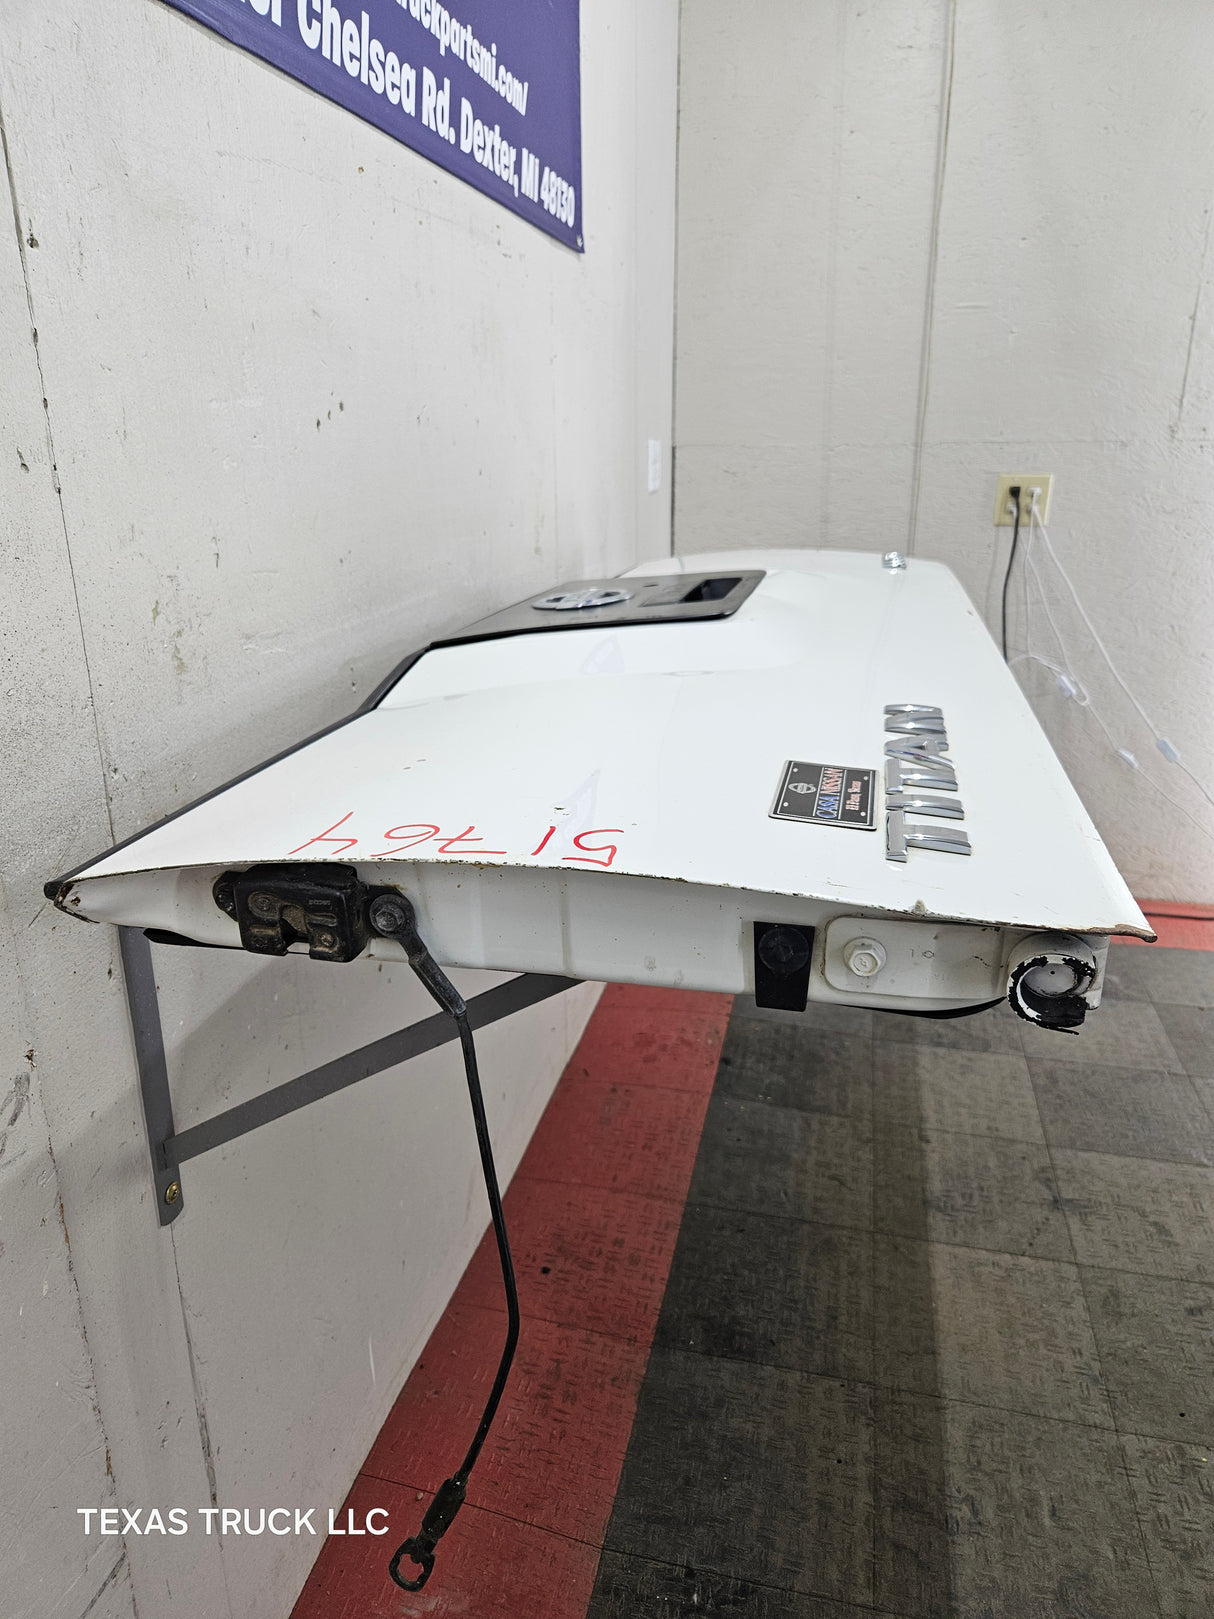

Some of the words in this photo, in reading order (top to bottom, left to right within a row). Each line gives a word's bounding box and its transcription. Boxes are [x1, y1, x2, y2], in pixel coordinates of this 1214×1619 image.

[297, 0, 416, 117] Chelsea
[422, 66, 456, 144] Rd.
[460, 97, 519, 197] Dexter,
[521, 147, 540, 203] MI
[540, 166, 575, 228] 48130
[396, 0, 529, 117] uckpartsmi.com/
[816, 796, 840, 818] CASA
[820, 768, 843, 795] NISSAN
[884, 704, 971, 863] TITAN
